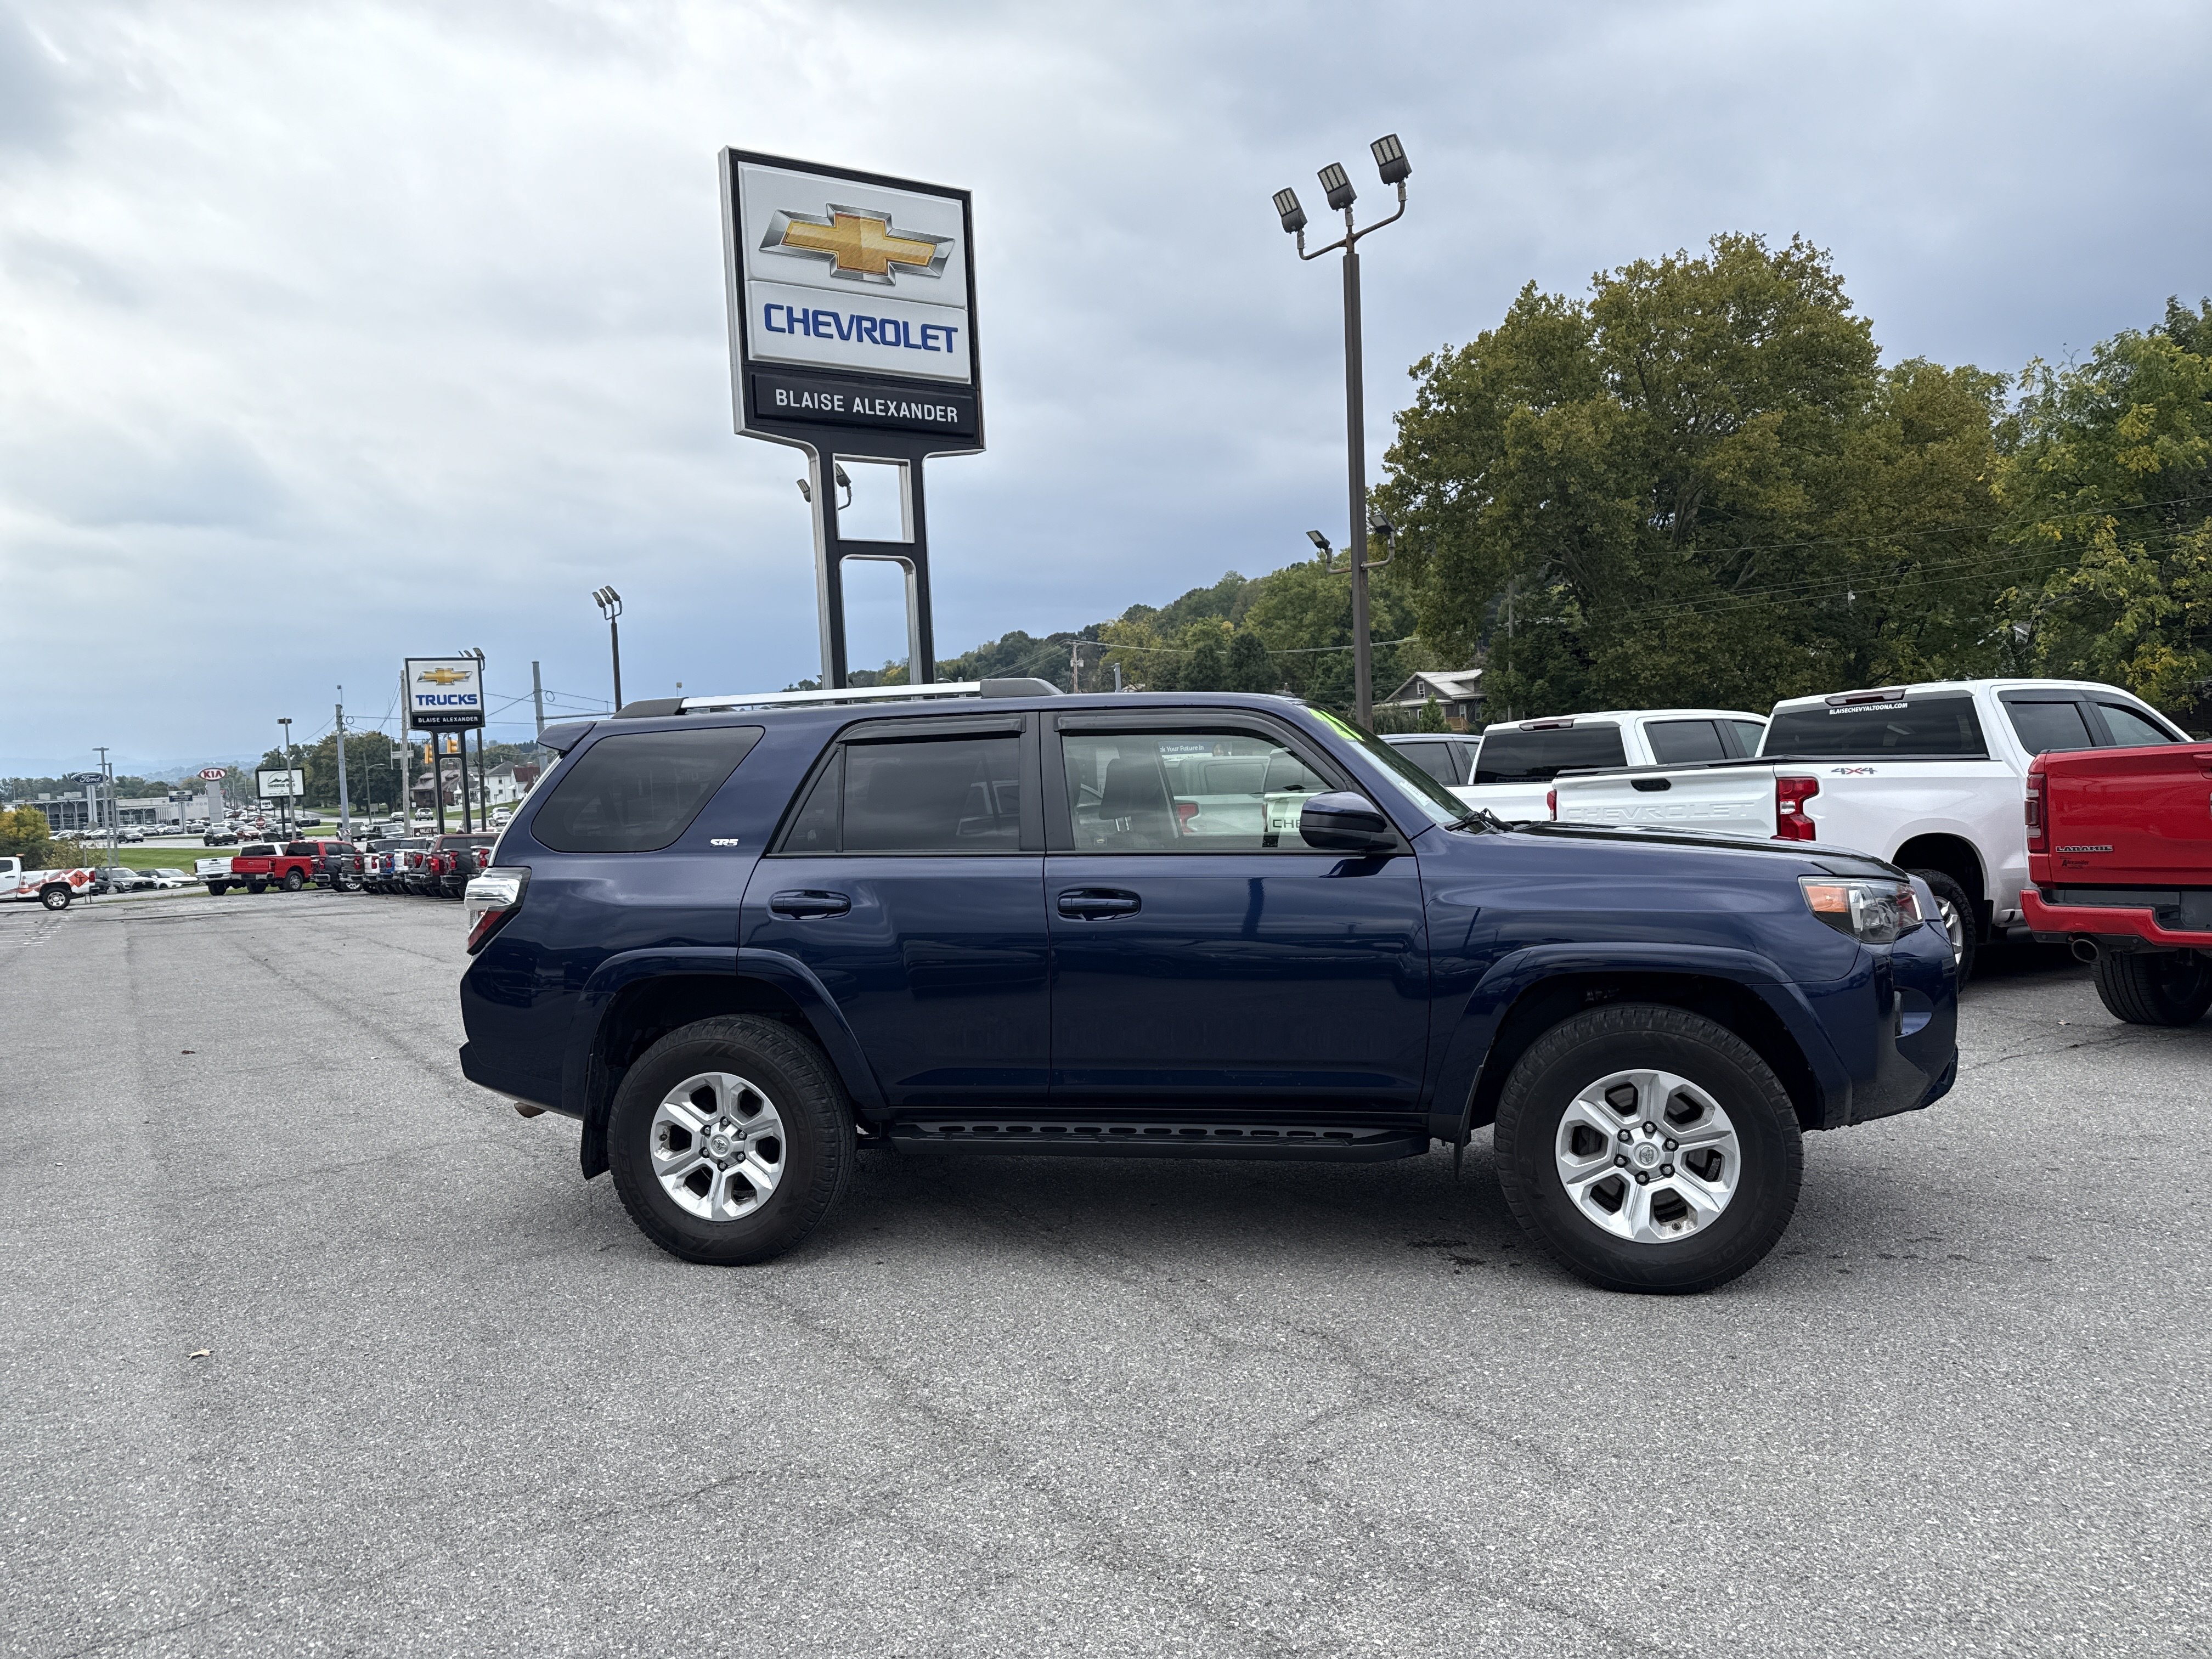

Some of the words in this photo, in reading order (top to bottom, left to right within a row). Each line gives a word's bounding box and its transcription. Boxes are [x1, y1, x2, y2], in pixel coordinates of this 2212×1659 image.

[764, 303, 958, 353] CHEVROLET
[775, 388, 845, 411] BLAISE
[852, 396, 958, 423] ALEXANDER
[415, 693, 477, 706] TRUCKS
[1829, 702, 1908, 715] BLAISECHEVYALTOONA.COM
[80, 774, 101, 782] Ford
[1566, 803, 1754, 821] CHEVROLET
